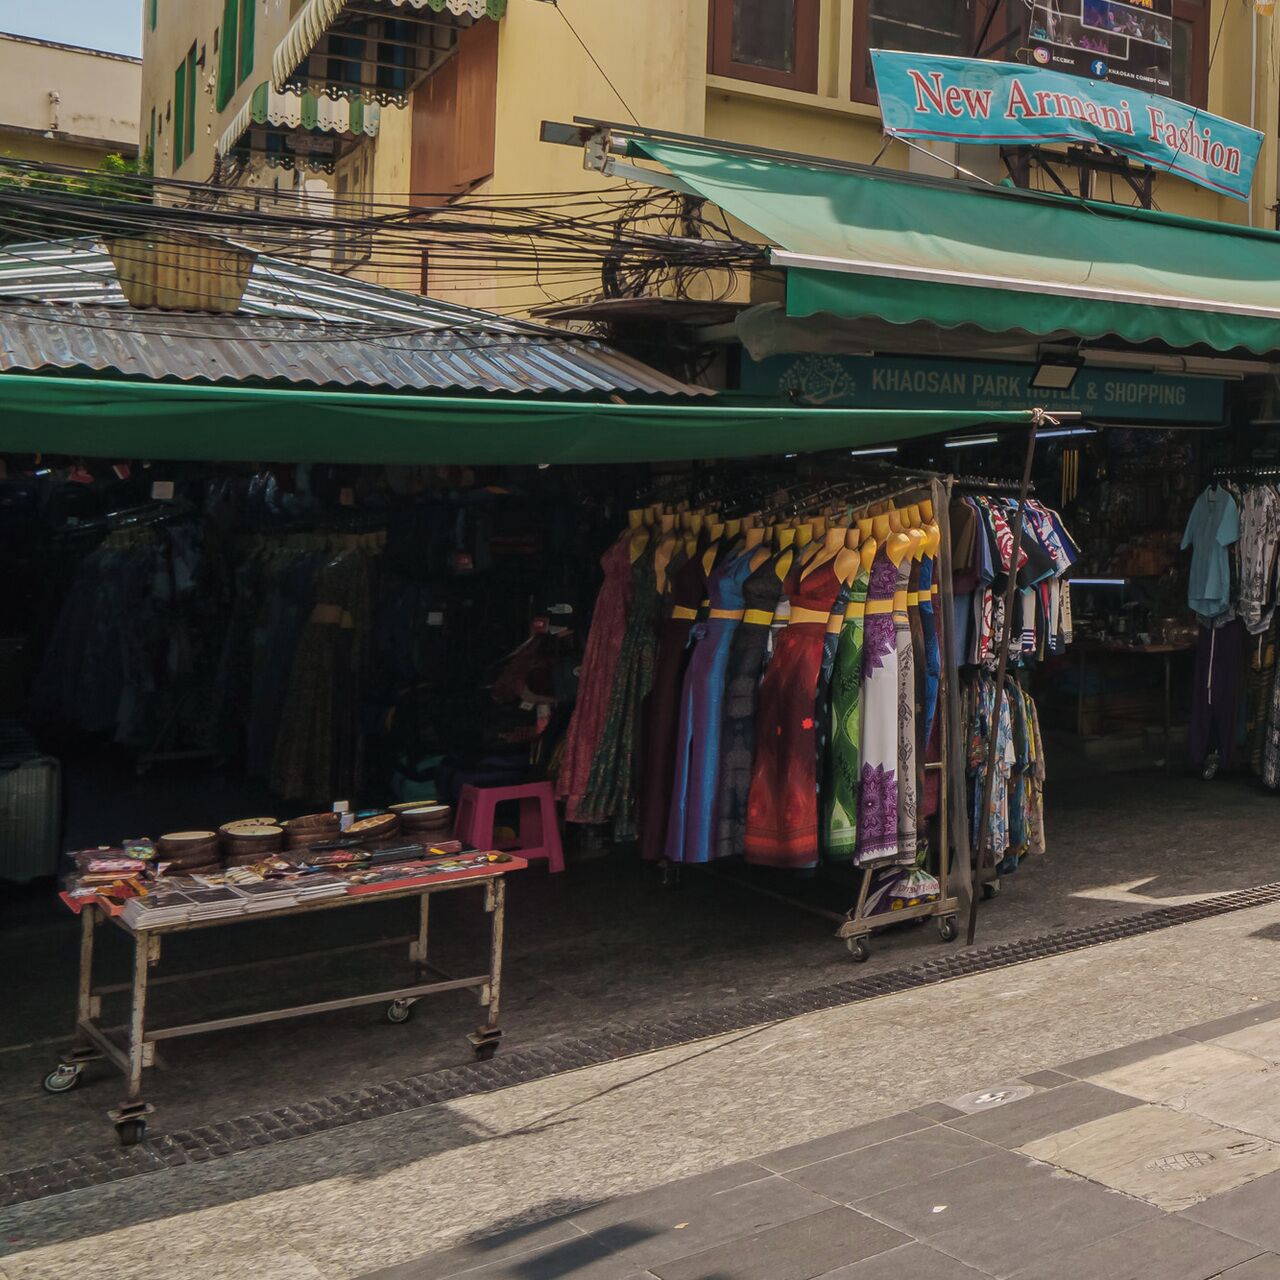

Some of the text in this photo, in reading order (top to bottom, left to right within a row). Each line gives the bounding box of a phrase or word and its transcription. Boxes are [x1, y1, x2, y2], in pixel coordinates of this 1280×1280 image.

[907, 69, 1243, 175] New Armani Fashion
[871, 369, 966, 396] KHAOSAN
[972, 373, 1021, 398] PARK
[1087, 382, 1098, 400] &
[1104, 382, 1186, 406] SHOPPING
